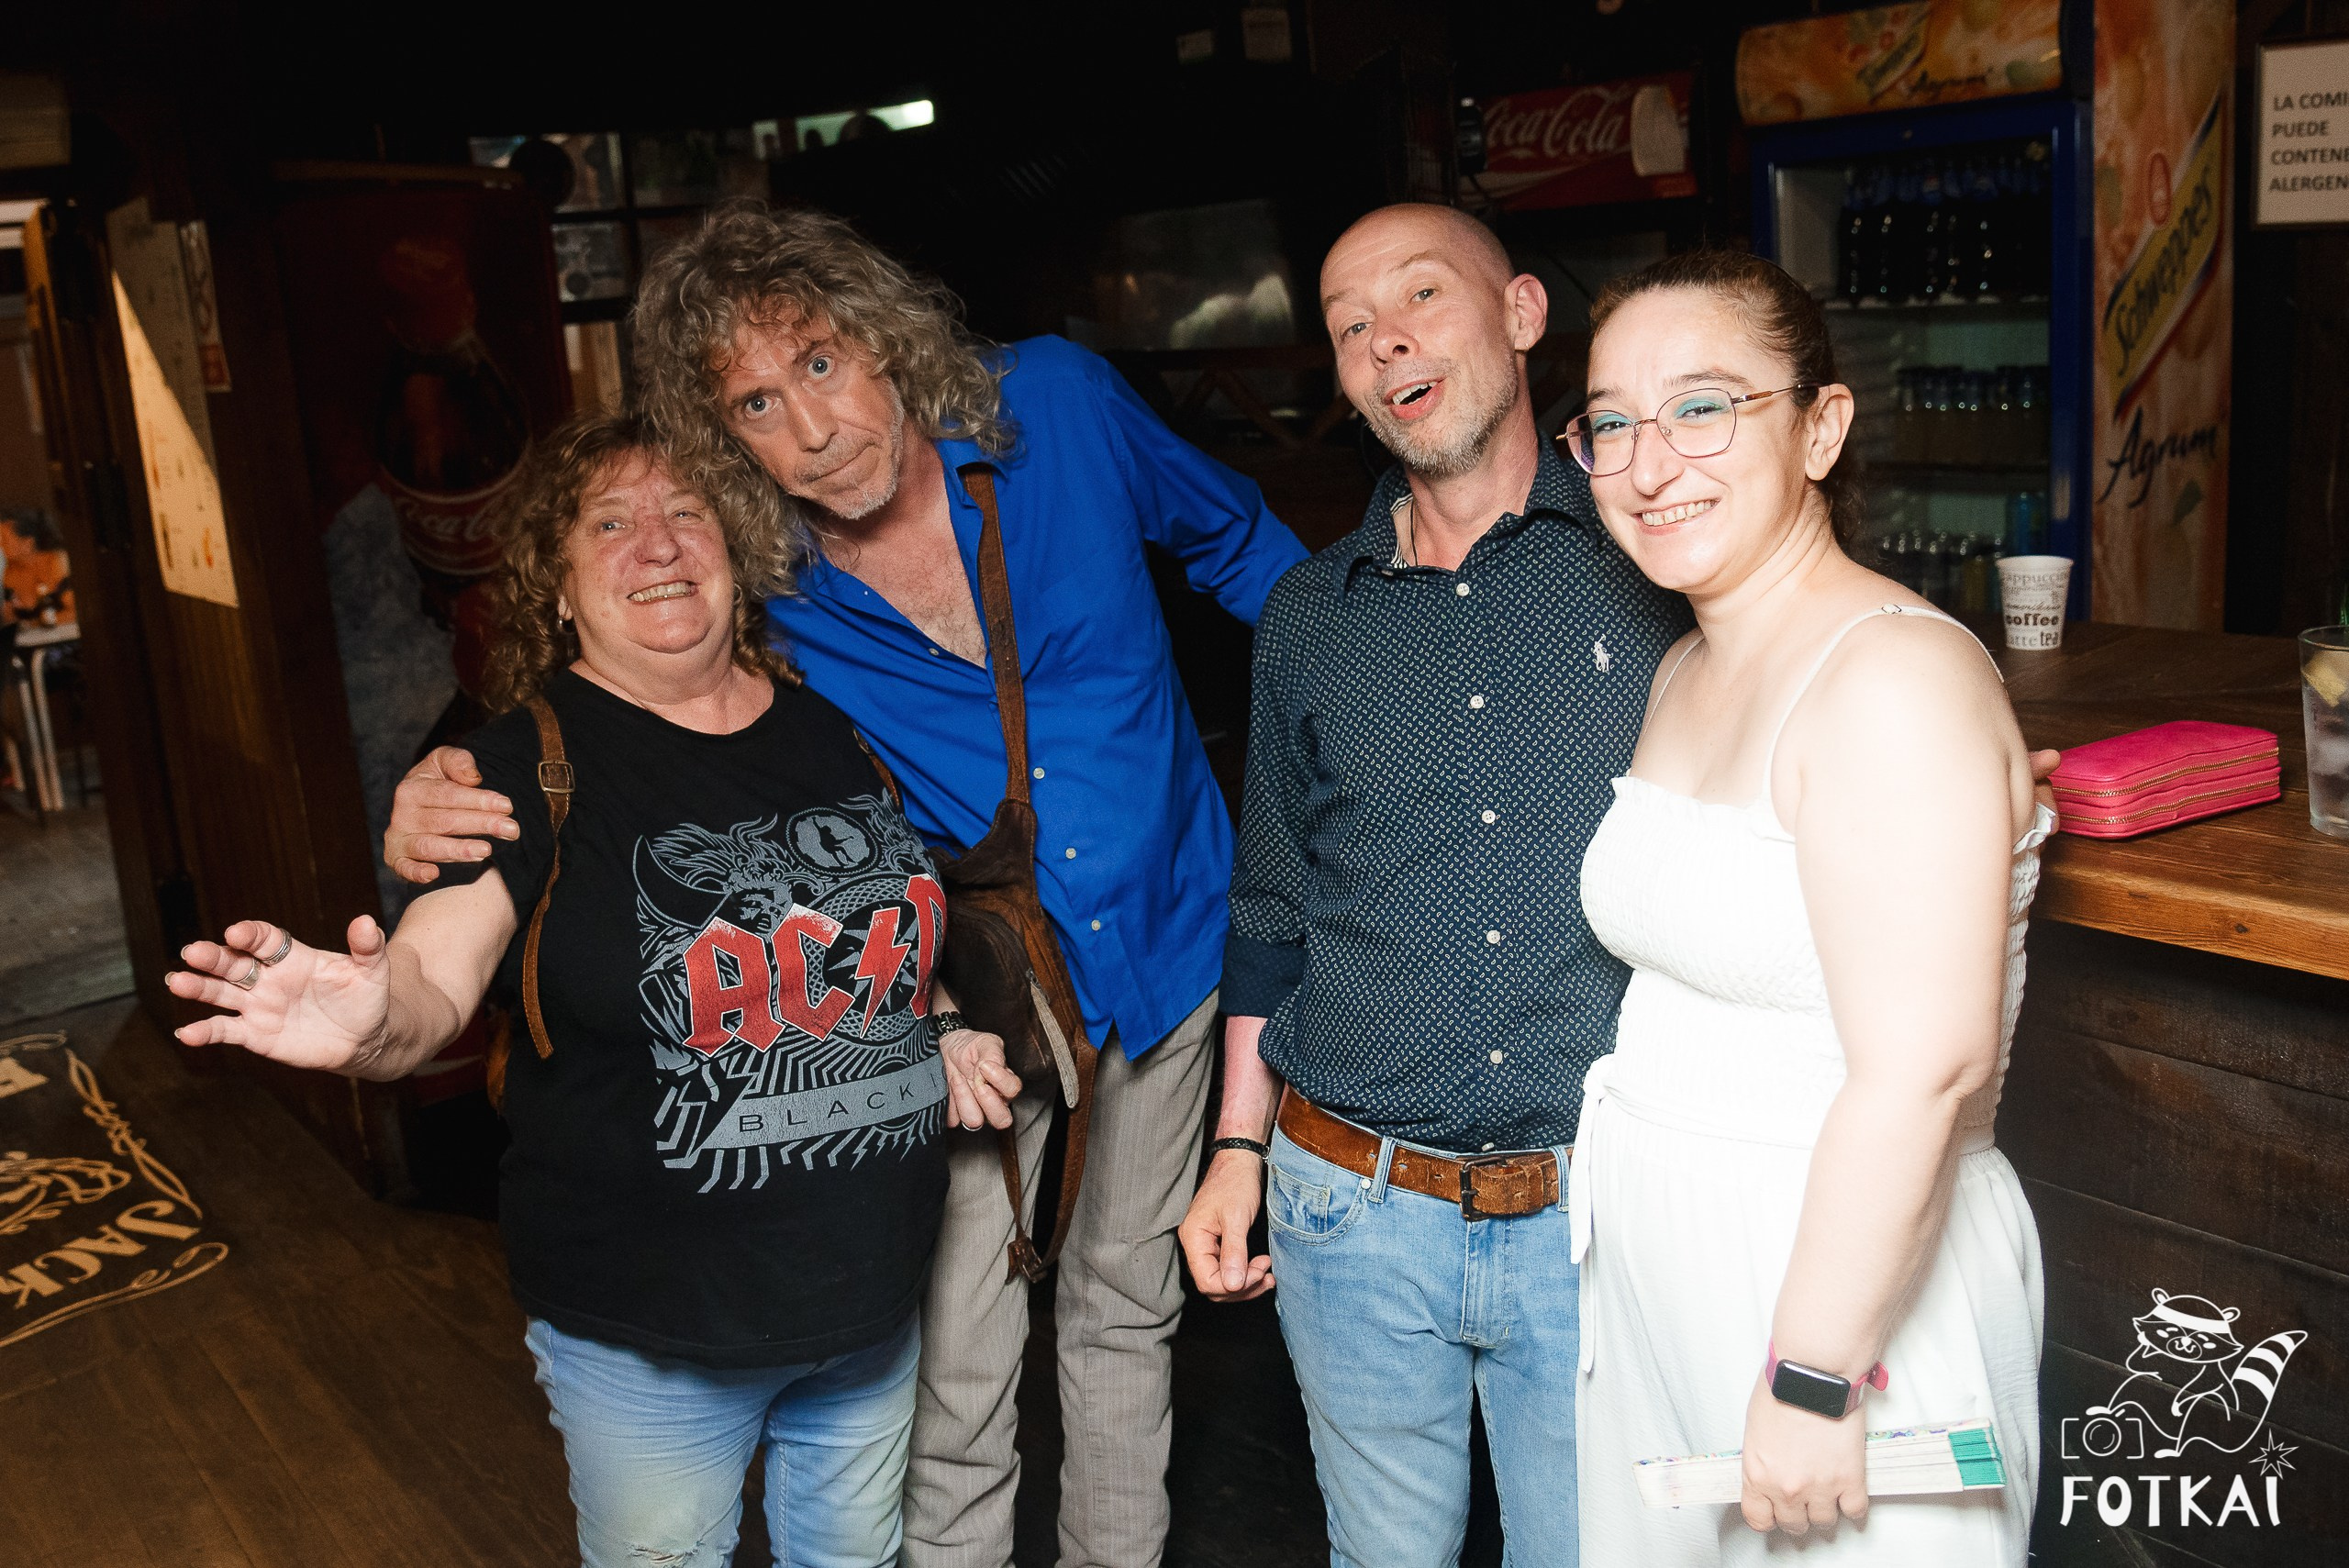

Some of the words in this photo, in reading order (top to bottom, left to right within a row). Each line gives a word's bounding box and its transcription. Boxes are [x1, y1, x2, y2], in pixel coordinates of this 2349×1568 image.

[2274, 95, 2293, 111] LA
[2273, 120, 2329, 138] PUEDE
[2270, 175, 2349, 192] ALERGEN
[2005, 613, 2060, 626] coffee
[738, 1085, 914, 1132] BLACK
[0, 1199, 202, 1310] JACK
